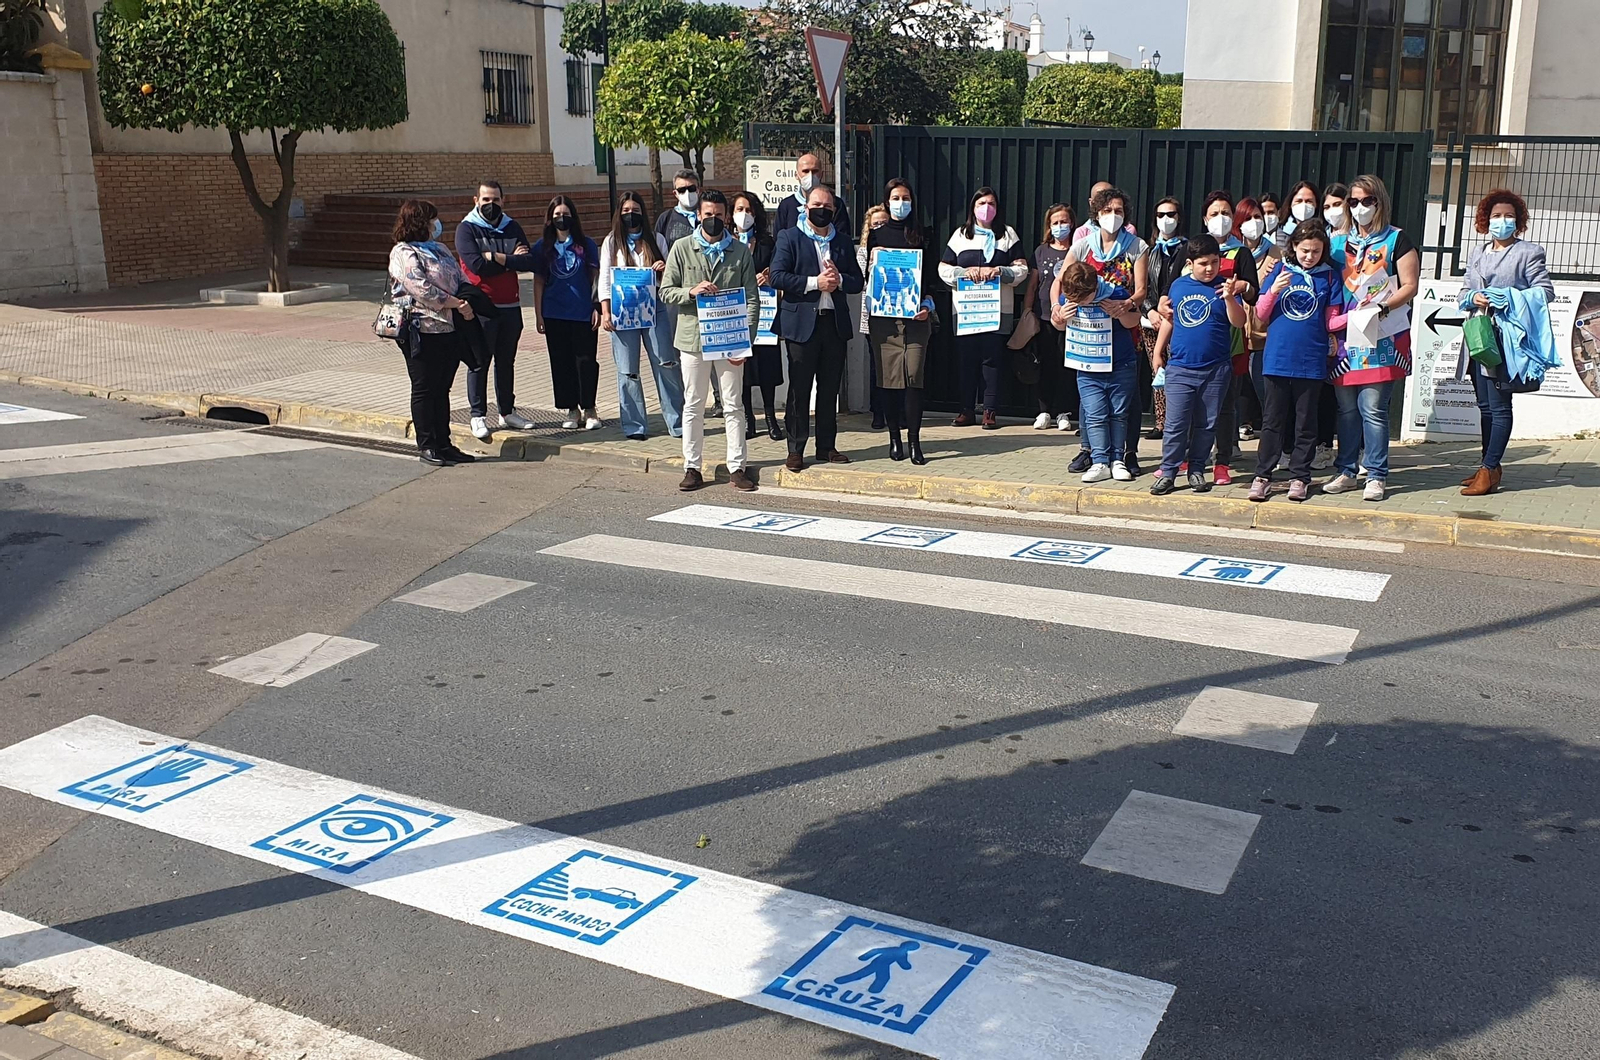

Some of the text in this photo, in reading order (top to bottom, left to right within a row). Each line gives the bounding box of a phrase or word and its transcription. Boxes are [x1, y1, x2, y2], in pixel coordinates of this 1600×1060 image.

[765, 181, 799, 192] Casas
[706, 309, 739, 318] PICTOGRAMAS
[1071, 320, 1104, 329] PICTOGRAMAS
[89, 784, 148, 801] PARA
[285, 838, 350, 861] MIRA
[509, 898, 612, 932] COCHE PARADO
[795, 979, 905, 1017] CRUZA
